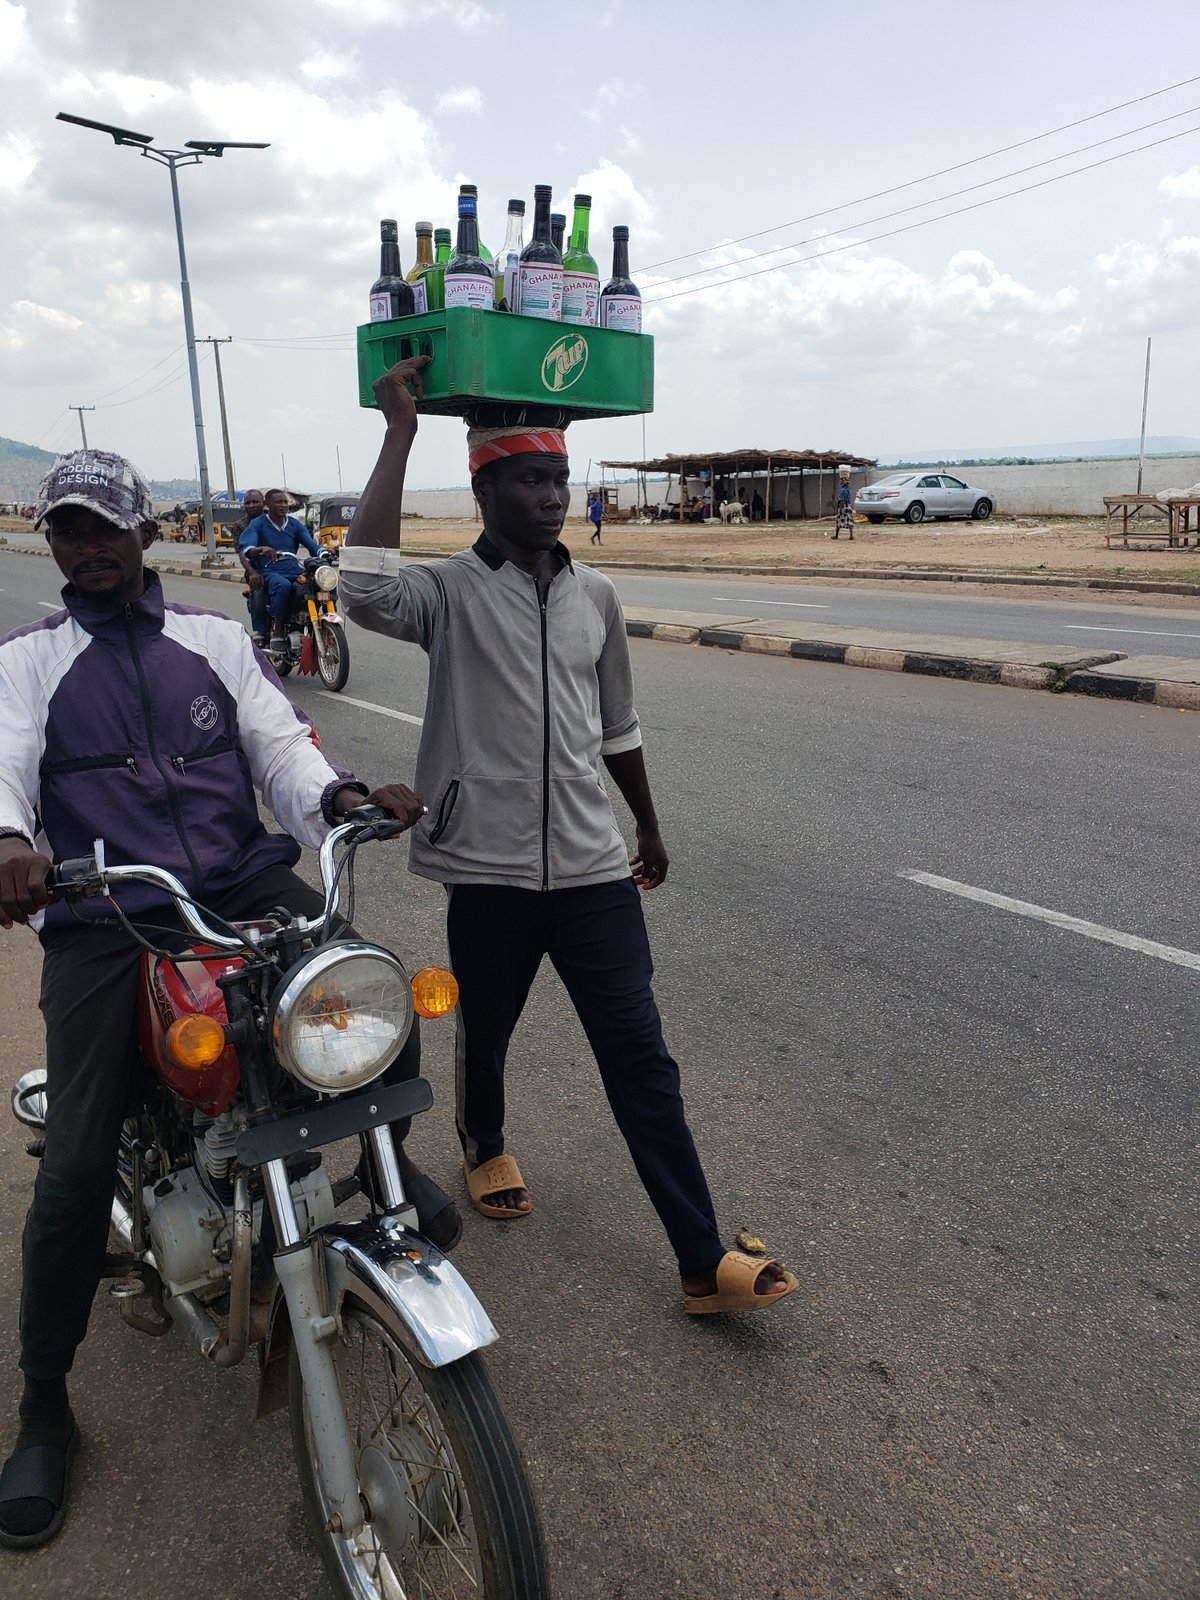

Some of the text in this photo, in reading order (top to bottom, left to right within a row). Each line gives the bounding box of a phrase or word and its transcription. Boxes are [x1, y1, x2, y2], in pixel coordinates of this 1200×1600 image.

[528, 273, 559, 285] GHANA
[448, 284, 476, 298] GHANA
[563, 282, 593, 293] GHANA
[58, 473, 109, 487] DESIGN
